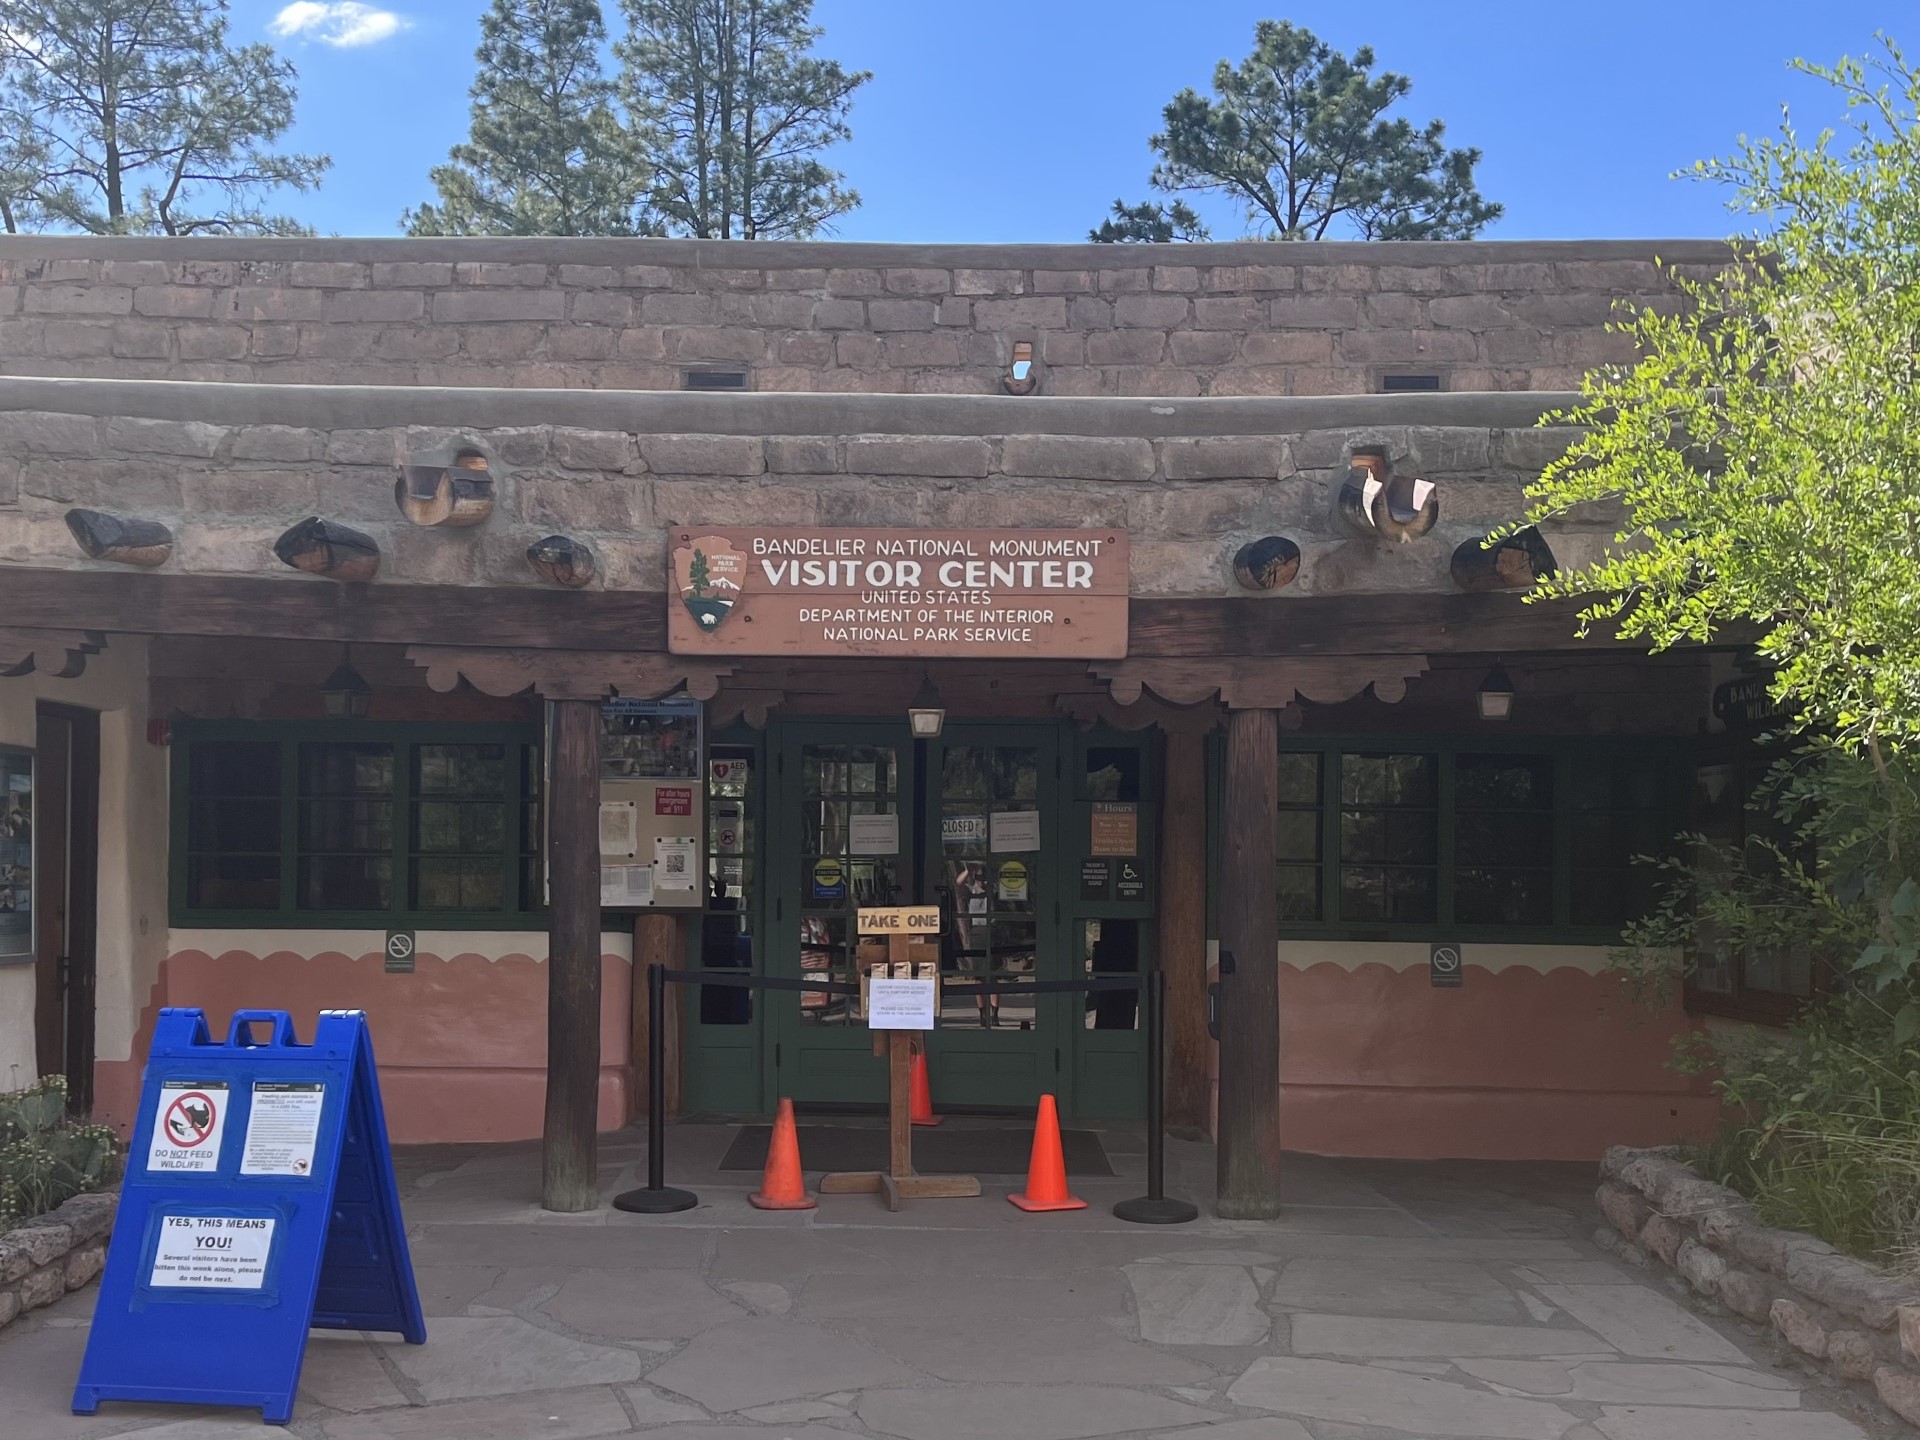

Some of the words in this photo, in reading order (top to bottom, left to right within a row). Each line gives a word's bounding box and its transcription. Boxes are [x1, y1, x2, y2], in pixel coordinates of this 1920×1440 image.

[753, 538, 866, 555] BANDELIER
[876, 538, 978, 557] NATIONAL
[989, 540, 1102, 557] MONUMENT
[761, 559, 922, 588] VISITOR
[938, 560, 1094, 589] CENTER
[861, 590, 921, 604] UNITED
[925, 590, 992, 605] STATES
[799, 609, 912, 622] DEPARTMENT
[917, 609, 938, 623] OF
[944, 610, 975, 623] THE
[980, 610, 1054, 623] INTERIOR
[823, 627, 908, 641] NATIONAL
[913, 628, 959, 641] PARK
[964, 628, 1032, 642] SERVICE
[657, 789, 665, 797] For
[677, 789, 690, 798] hours
[673, 805, 683, 814] 911
[1104, 804, 1133, 812] Hours
[942, 820, 974, 833] CLOSED
[859, 915, 899, 928] TAKE
[907, 915, 938, 927] ONE
[155, 1149, 168, 1157] DO
[170, 1150, 188, 1159] NOT
[161, 1161, 204, 1169] WILDLIFE!
[168, 1217, 193, 1228] YES,
[197, 1218, 223, 1228] THIS
[226, 1219, 266, 1229] MEANS
[194, 1236, 233, 1250] YOU!
[237, 1266, 262, 1274] please
